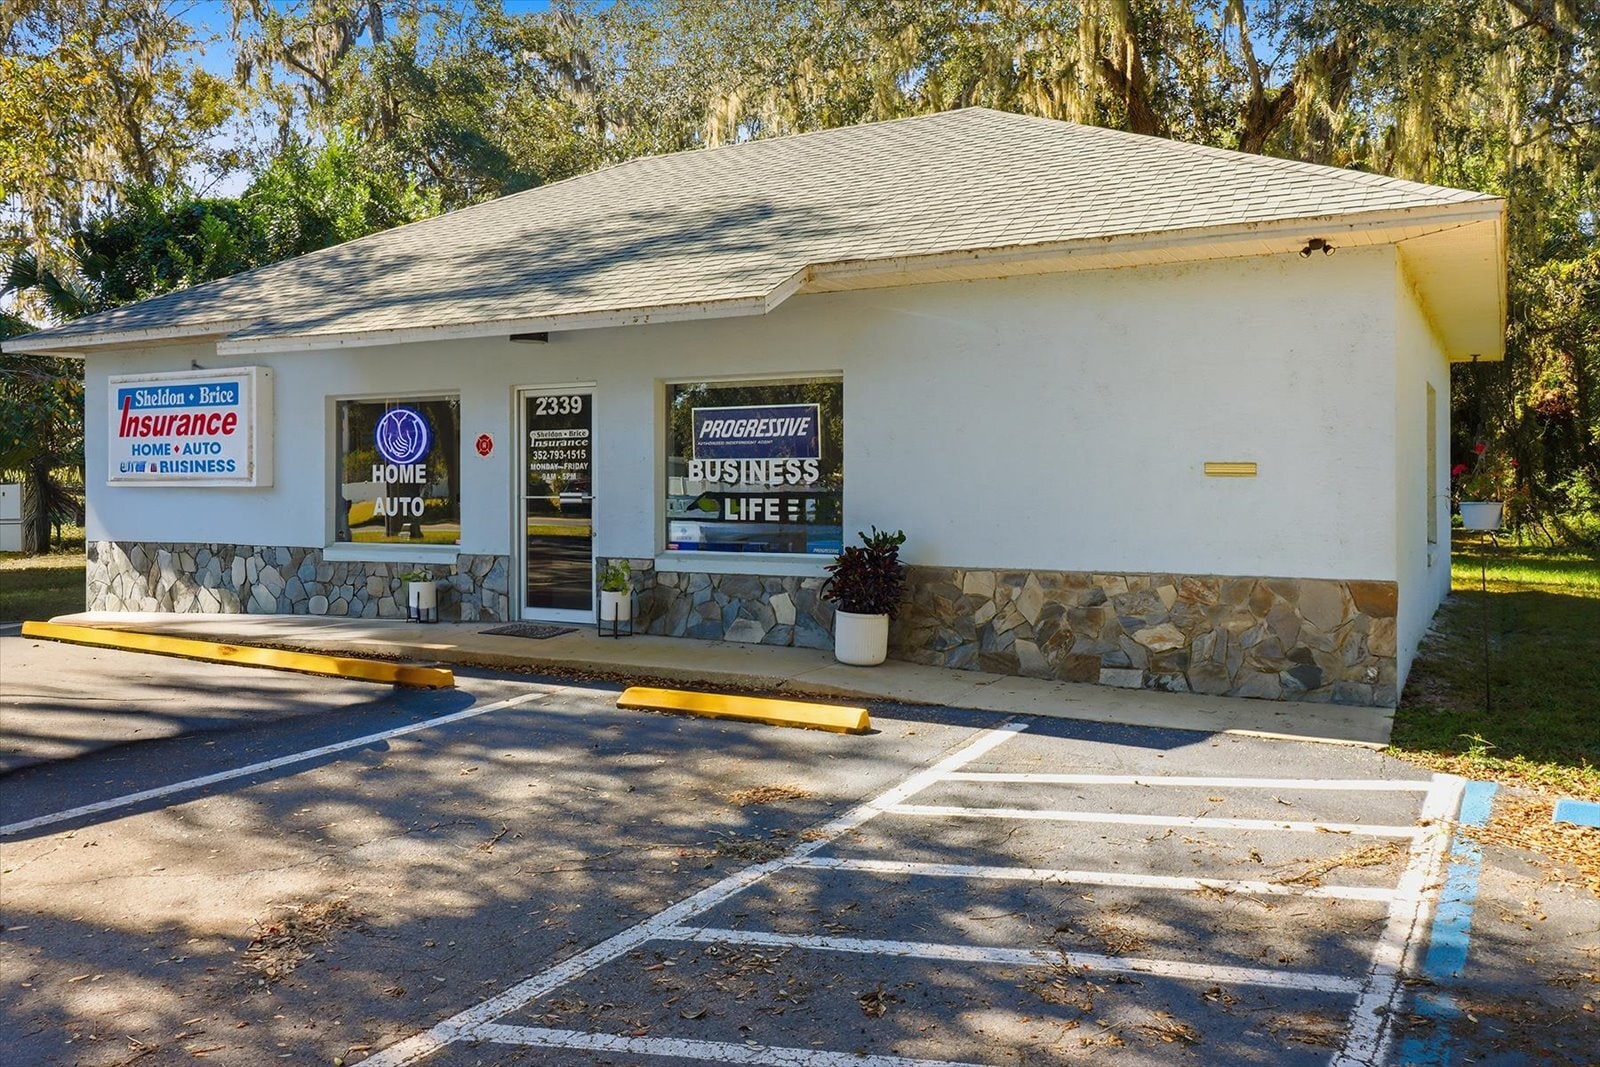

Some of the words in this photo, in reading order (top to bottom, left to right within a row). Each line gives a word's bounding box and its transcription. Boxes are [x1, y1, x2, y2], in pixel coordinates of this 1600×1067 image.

[135, 387, 185, 407] Sheldon
[199, 385, 234, 404] Brice
[535, 396, 583, 415] 2339
[119, 395, 237, 438] Insurance
[537, 430, 563, 438] Sheldon
[699, 417, 811, 438] PROGRESSIVE
[132, 443, 171, 456] HOME
[182, 442, 222, 455] AUTO
[531, 438, 589, 447] Insurance
[533, 449, 586, 460] 352-793-1515
[371, 464, 427, 484] HOME
[688, 459, 820, 485] BUSINESS
[373, 496, 425, 517] AUTO
[724, 497, 780, 522] LIFE
